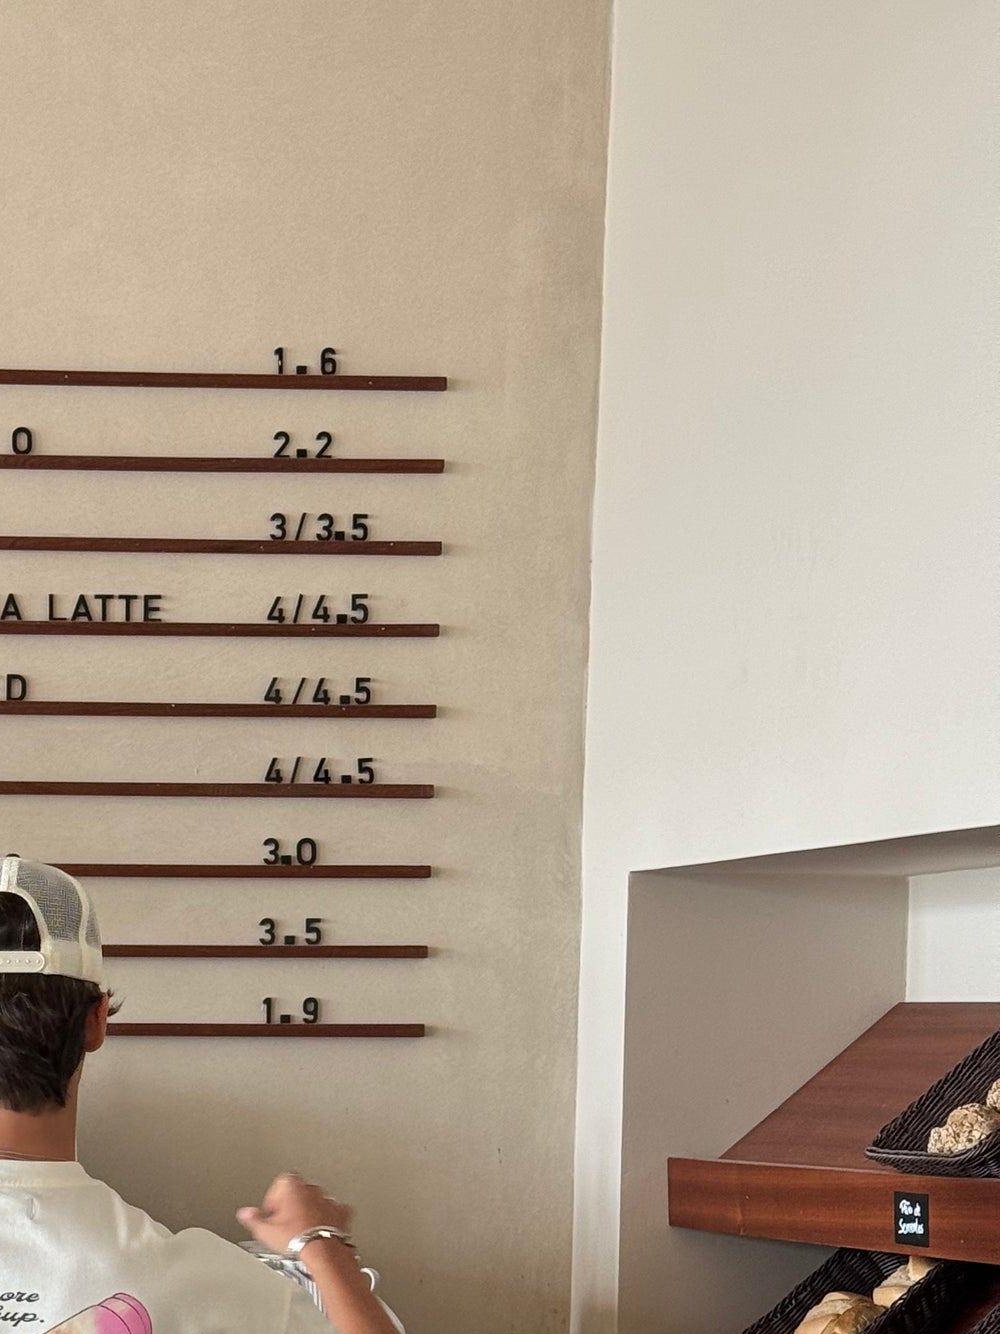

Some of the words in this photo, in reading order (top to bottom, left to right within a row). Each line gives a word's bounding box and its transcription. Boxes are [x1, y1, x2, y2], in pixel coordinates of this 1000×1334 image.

[273, 347, 338, 375] 1.6
[272, 431, 334, 460] 2.2
[268, 512, 370, 542] 3/3.5
[48, 594, 163, 623] LATTE
[266, 594, 370, 625] 4/4.5
[263, 677, 372, 706] 4/4.5
[264, 756, 376, 786] 4/4.5
[262, 837, 318, 866] 3.0
[258, 917, 323, 947] 3.5
[262, 996, 320, 1025] 1.9
